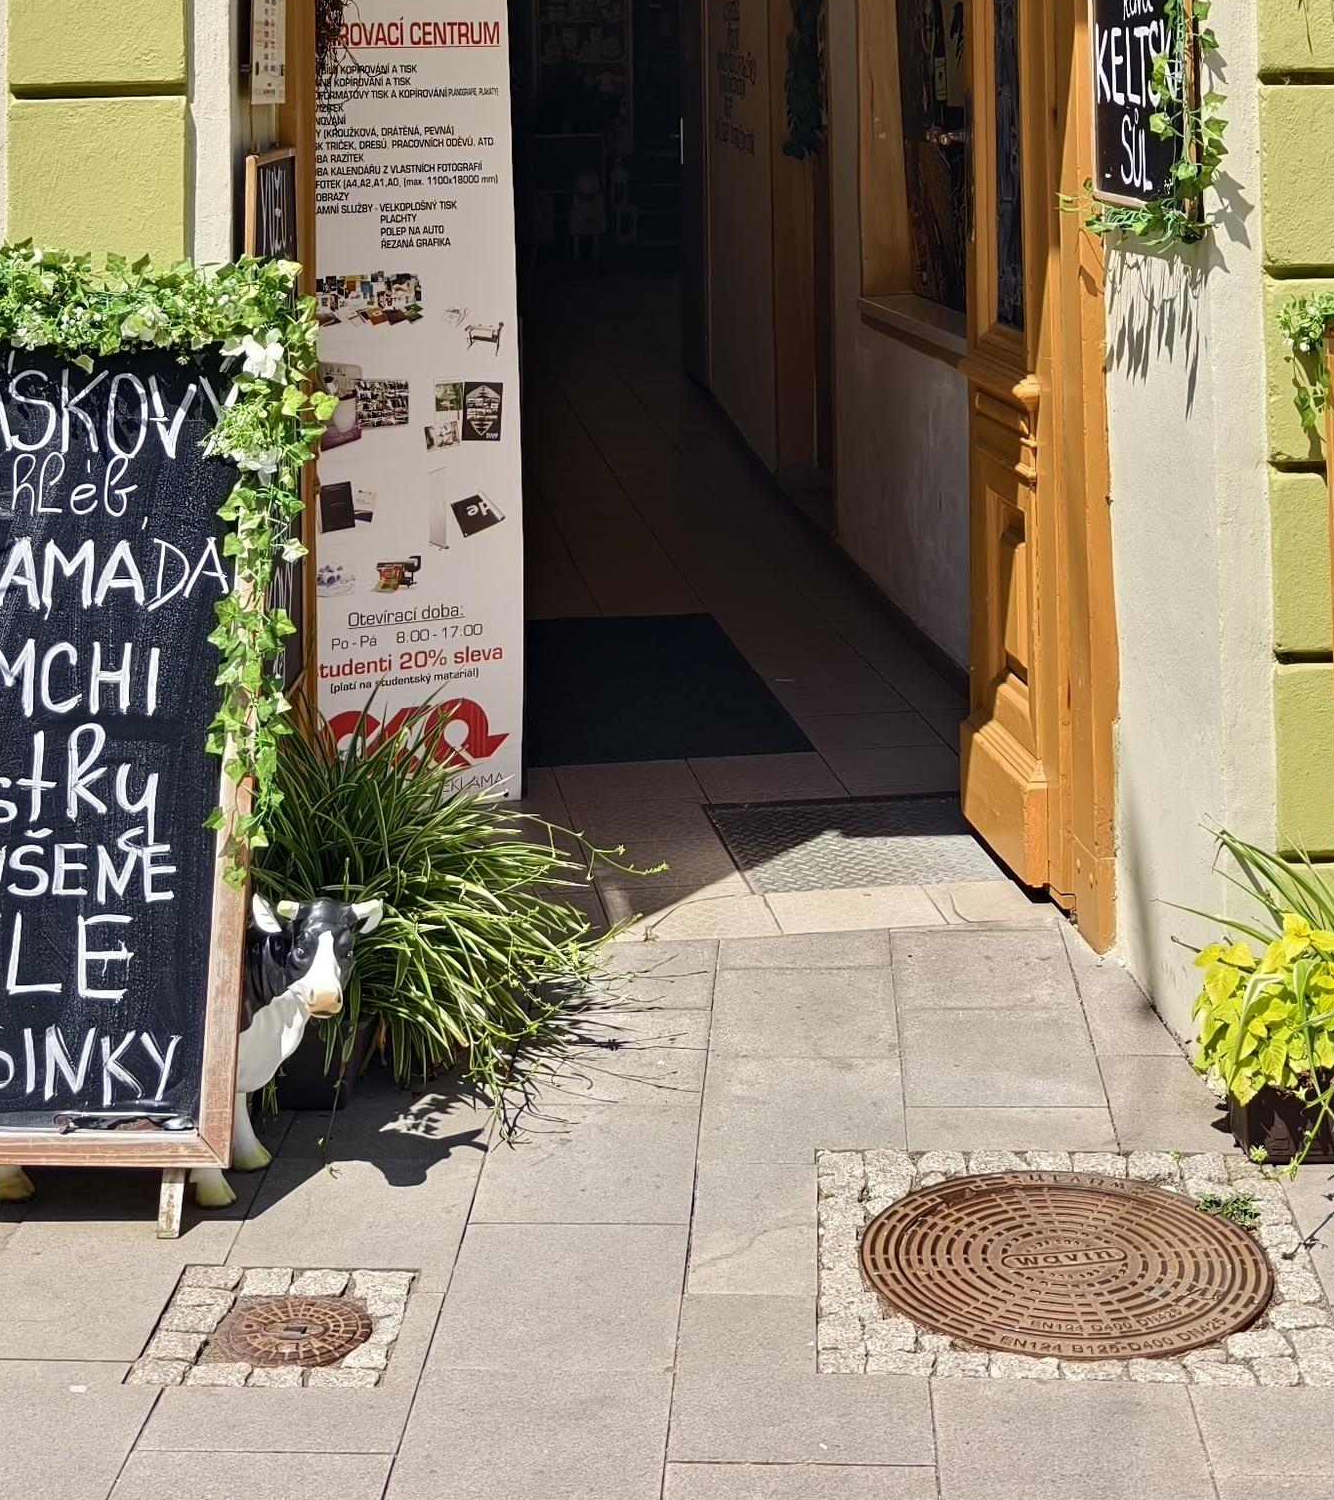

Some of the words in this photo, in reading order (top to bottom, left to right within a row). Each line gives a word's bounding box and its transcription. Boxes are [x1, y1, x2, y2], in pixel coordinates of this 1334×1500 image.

[410, 20, 500, 46] CENTRUM
[399, 64, 418, 74] TISK
[1095, 18, 1184, 108] KELTSK
[334, 75, 384, 87] KOPÍROVÁNÍ
[393, 76, 411, 87] TISK
[316, 89, 370, 100] FORMÁTOVÝ
[371, 90, 390, 100] TISK
[398, 86, 448, 99] KOPÍROVÁNÍ
[391, 136, 444, 149] PRACOVNÍCH
[330, 152, 365, 163] RAZÍTEK
[390, 162, 436, 175] VLASTNÍCH
[436, 160, 483, 173] FOTOGRAFIÍ
[427, 174, 480, 186] 1100x18000
[481, 173, 499, 184] mm)
[316, 203, 340, 215] AMNÍ
[341, 202, 374, 214] SLUŽBY
[379, 199, 438, 213] VELKOPLOŠNÝ
[439, 200, 458, 211] TISK
[380, 214, 417, 224] PLACHTY
[380, 226, 407, 237] POLEP
[408, 226, 421, 236] NA
[422, 225, 445, 235] AUTO
[381, 237, 415, 249] ŘEZANÁ
[416, 237, 451, 248] GRAFIKA
[348, 607, 418, 628] Otevírací
[421, 603, 465, 621] doba:
[331, 637, 349, 651] Po
[360, 634, 377, 648] Pá
[396, 629, 430, 644] 8.00
[441, 623, 483, 640] 17.00
[399, 648, 447, 671] 20%
[453, 645, 504, 665] sleva
[330, 681, 357, 695] (platí
[359, 680, 372, 690] na
[375, 673, 432, 689] studentský
[433, 666, 479, 683] materiál)
[1015, 1249, 1115, 1267] wavin
[999, 1334, 1063, 1354] EN124
[1176, 1316, 1228, 1343] DN425
